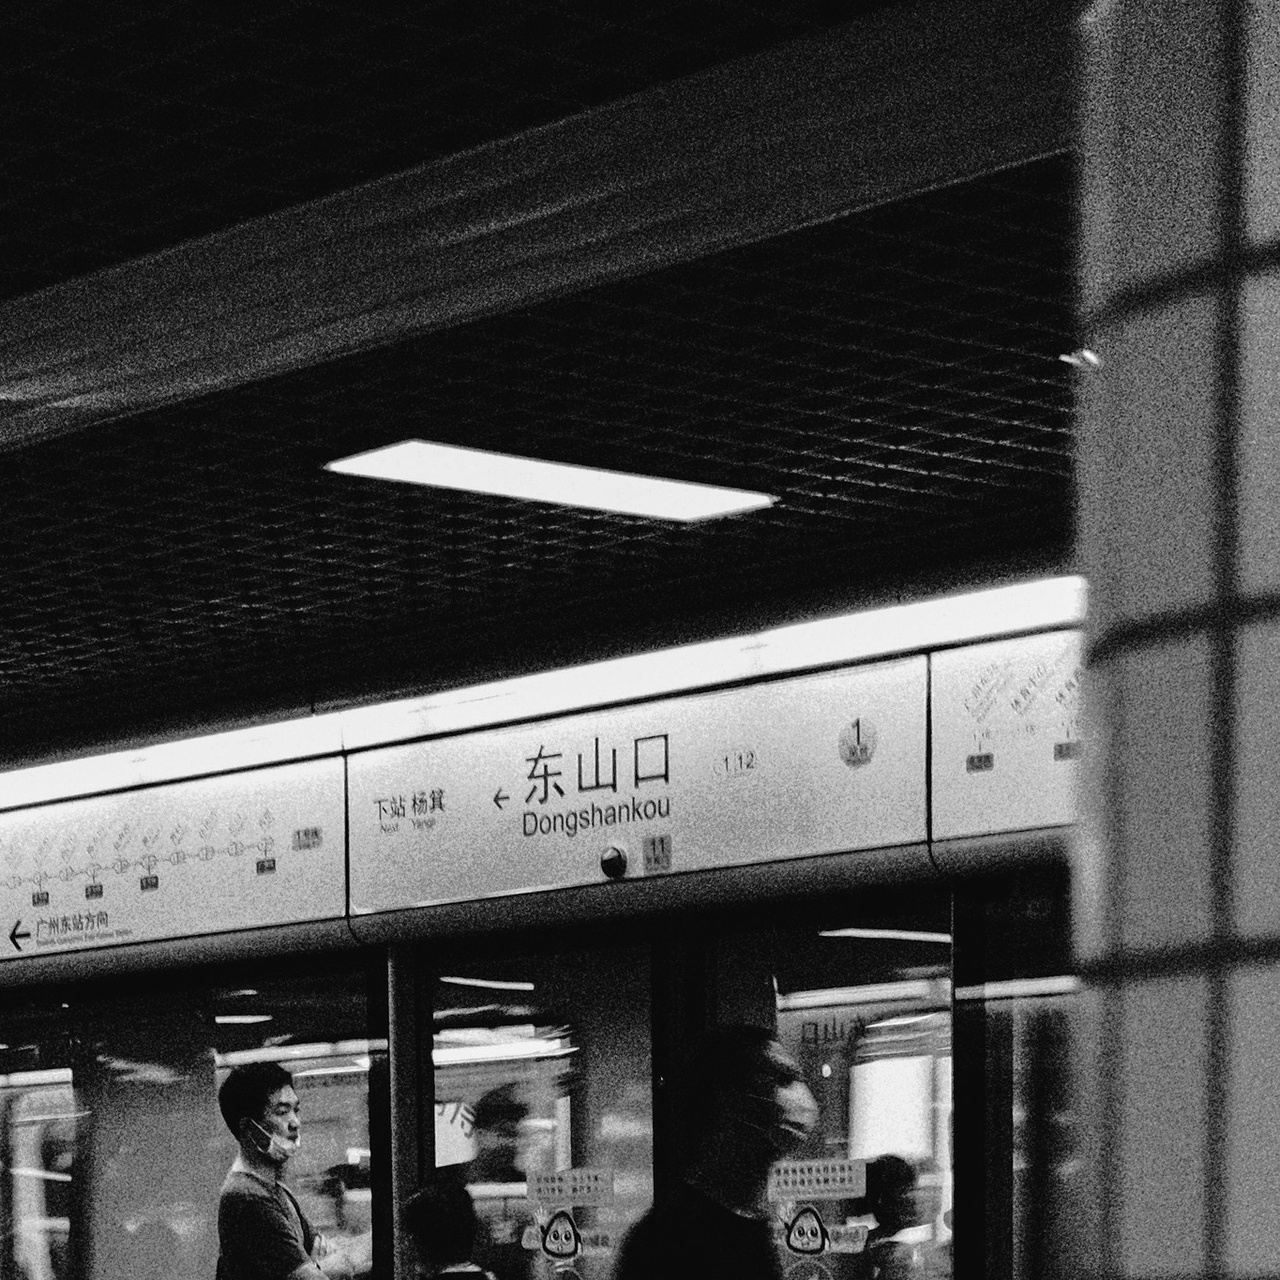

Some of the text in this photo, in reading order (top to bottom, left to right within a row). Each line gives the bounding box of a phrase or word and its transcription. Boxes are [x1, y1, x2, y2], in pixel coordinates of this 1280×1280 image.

[851, 718, 860, 746] 1
[525, 733, 669, 805] 东山口
[373, 788, 445, 820] 下站 杨箕
[522, 796, 670, 838] Dongshankou
[650, 836, 665, 856] 11
[36, 910, 108, 939] 广州东站方向
